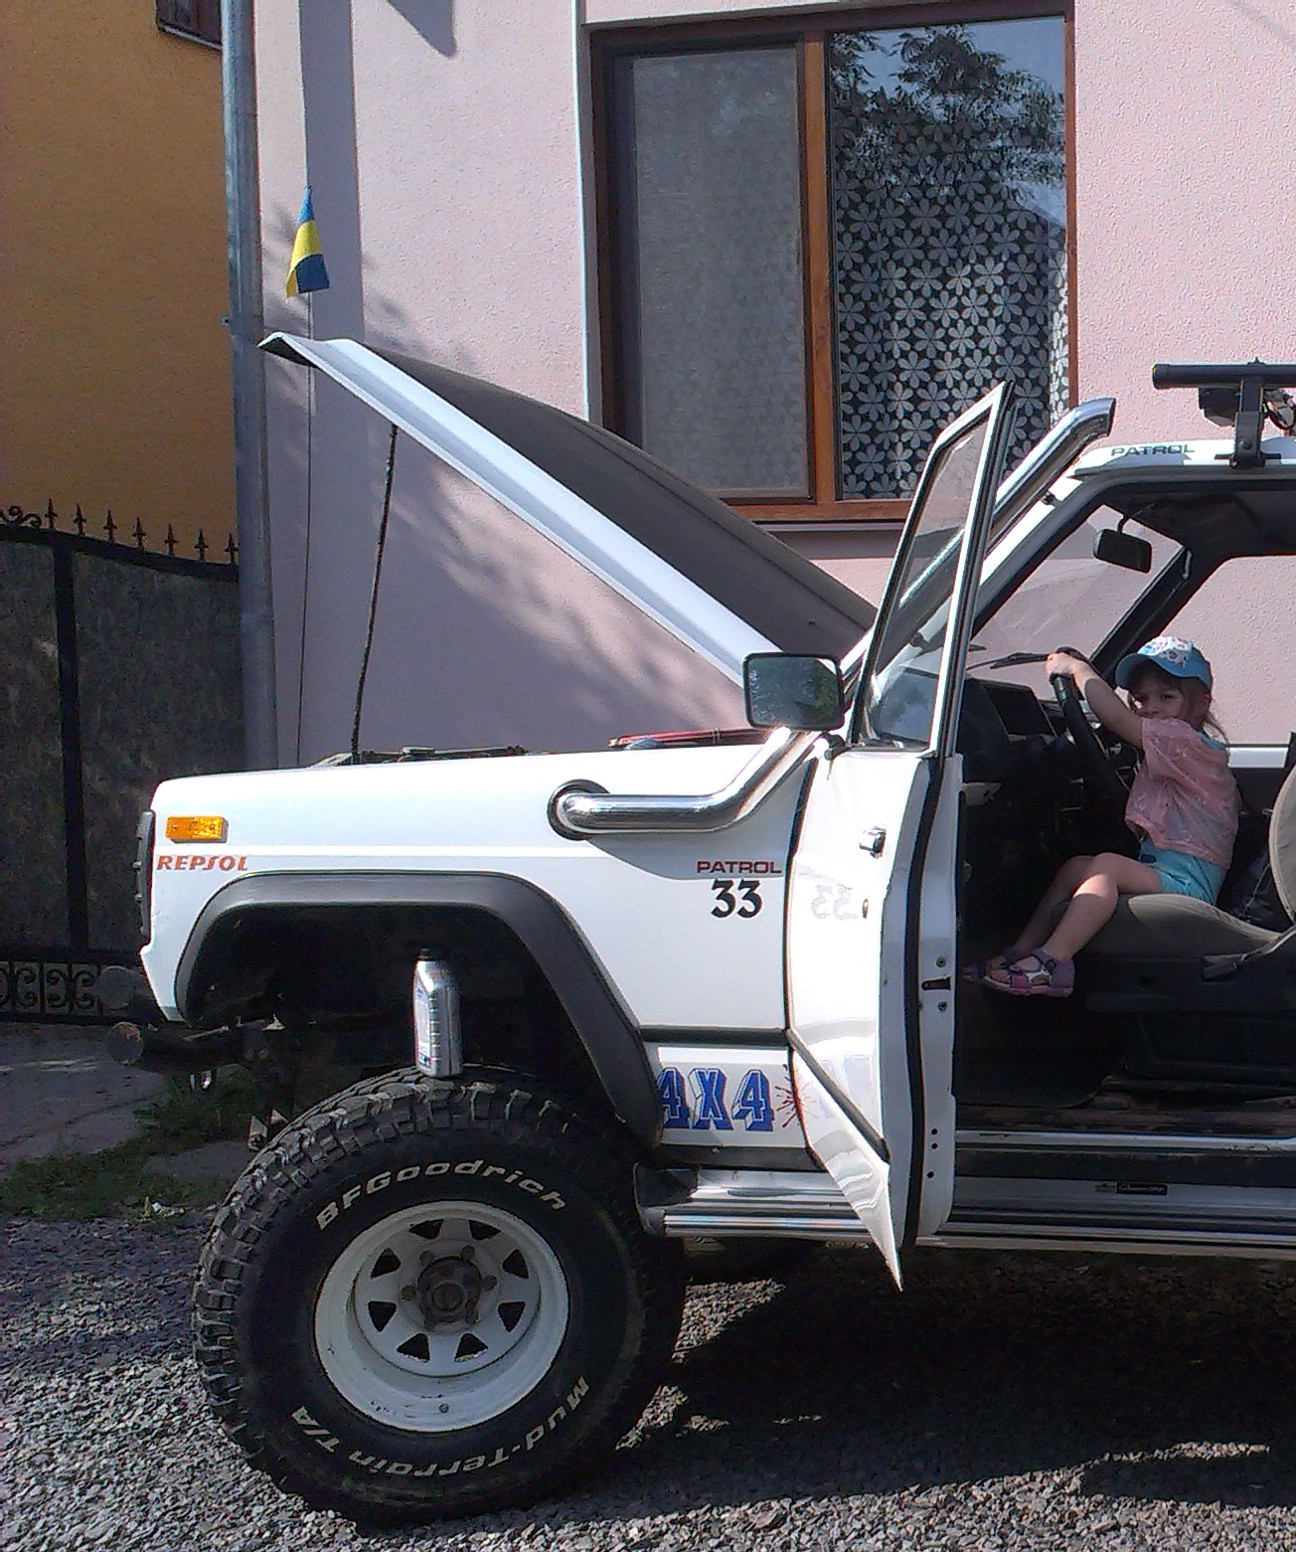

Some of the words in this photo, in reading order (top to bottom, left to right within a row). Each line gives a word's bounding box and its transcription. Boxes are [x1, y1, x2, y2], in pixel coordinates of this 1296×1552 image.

[1110, 444, 1196, 457] PATROL
[156, 855, 248, 871] REPSOL
[697, 861, 782, 874] PATROL
[710, 878, 763, 918] 33
[316, 1159, 567, 1231] BFGoodrich
[290, 1405, 340, 1453] T/A
[348, 1376, 590, 1478] Mud-Terrain
